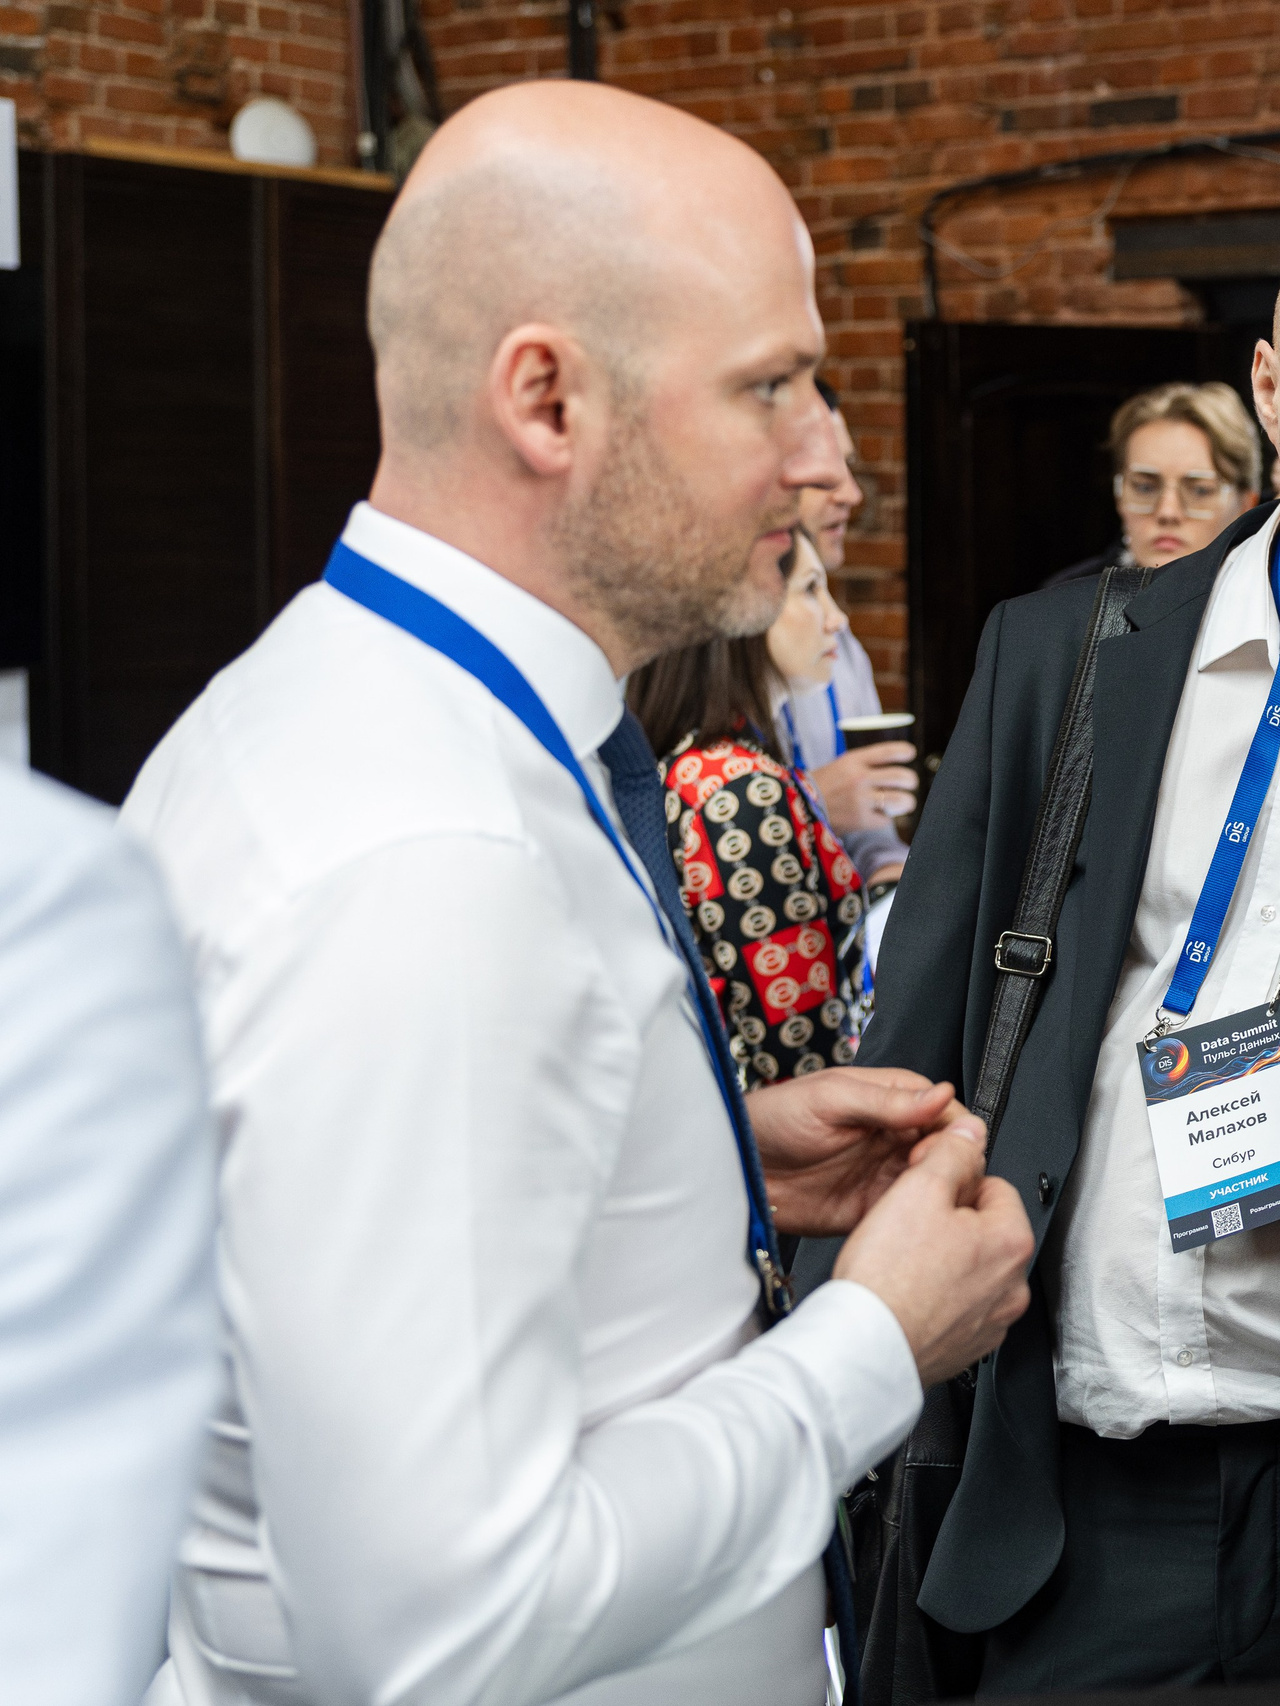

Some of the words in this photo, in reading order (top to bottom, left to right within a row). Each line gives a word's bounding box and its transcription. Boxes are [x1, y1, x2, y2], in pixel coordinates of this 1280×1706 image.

[1229, 821, 1245, 843] DIS
[1190, 940, 1206, 963] DIS
[1200, 1034, 1230, 1053] Data
[1231, 1019, 1279, 1043] Summit
[1203, 1047, 1237, 1065] Пульс
[1238, 1031, 1280, 1056] Данных
[1158, 1058, 1173, 1069] DIS
[1186, 1090, 1262, 1126] Алексей
[1187, 1112, 1268, 1147] Малахов
[1212, 1148, 1256, 1170] Сибур
[1209, 1172, 1269, 1200] УЧАСТНИК
[1172, 1223, 1209, 1240] Программа
